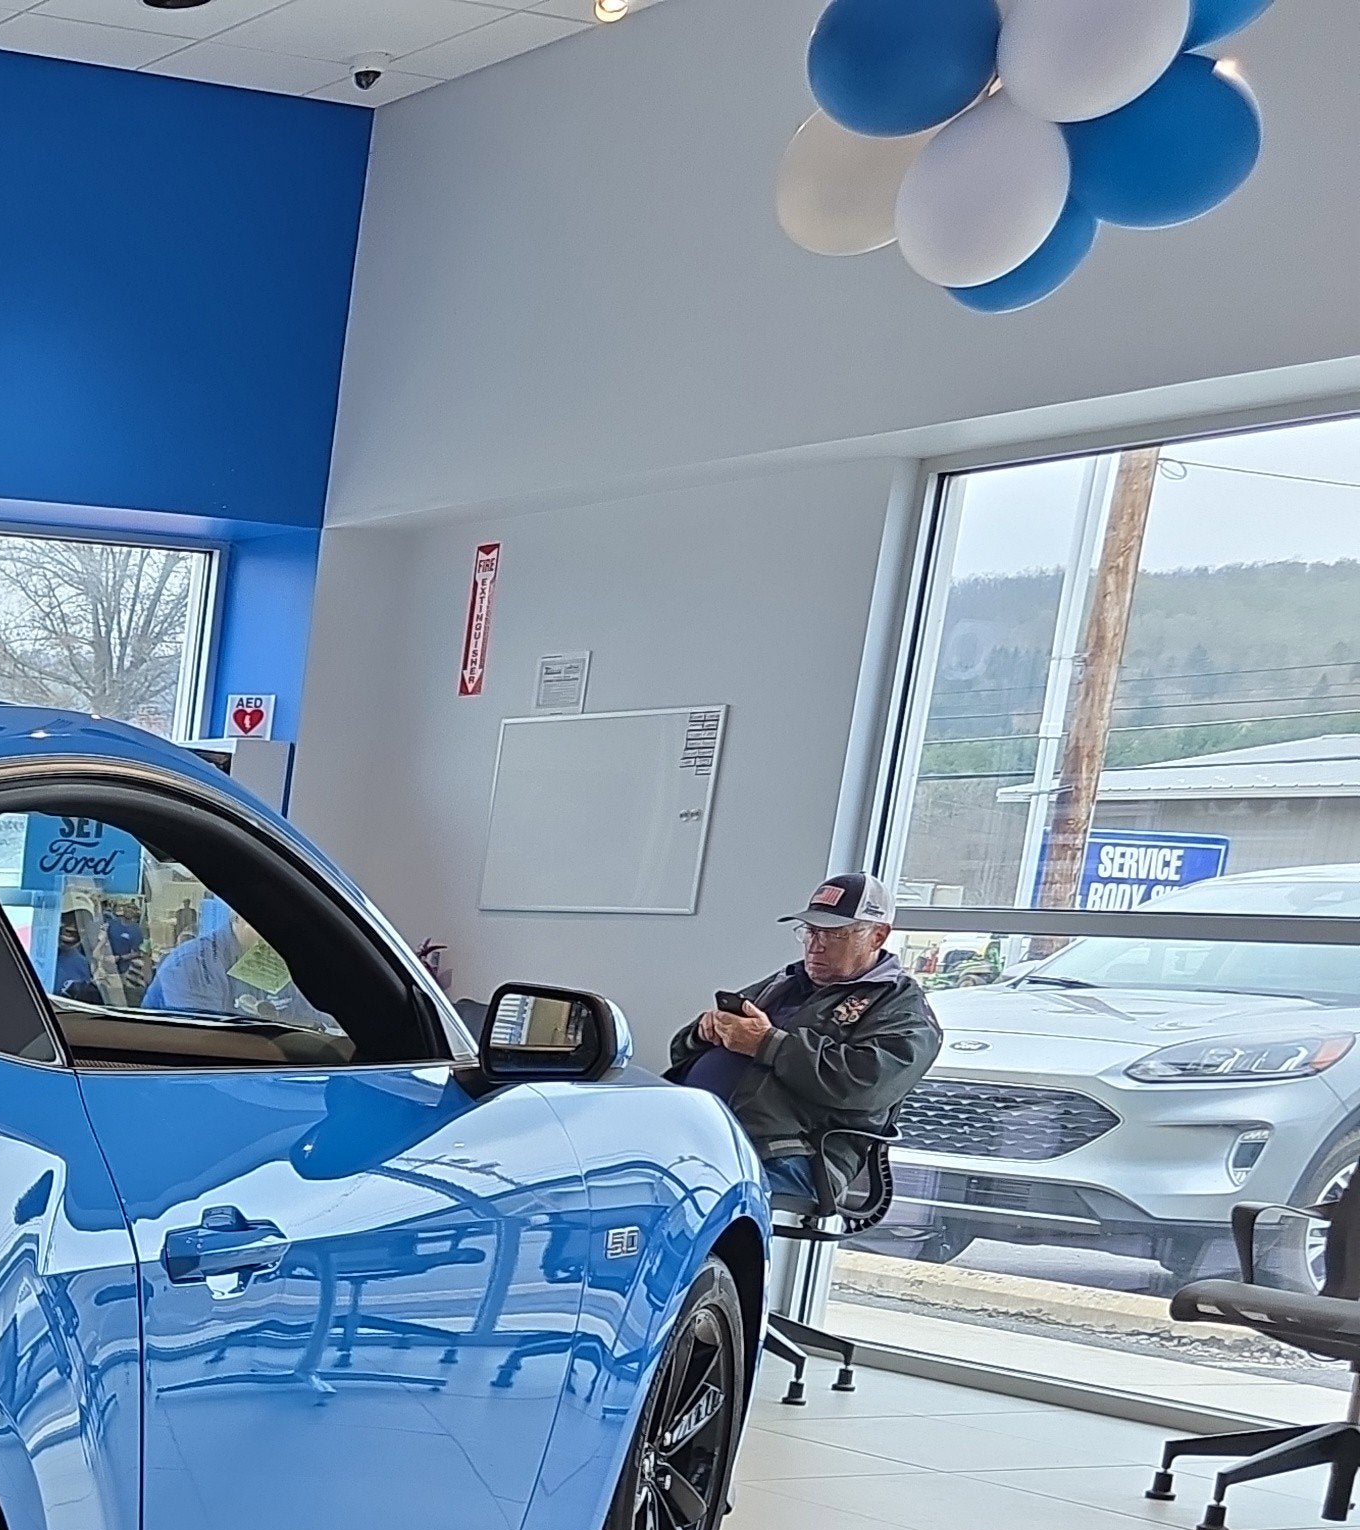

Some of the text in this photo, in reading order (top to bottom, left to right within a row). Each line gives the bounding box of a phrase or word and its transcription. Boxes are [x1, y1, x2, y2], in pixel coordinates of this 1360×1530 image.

[468, 578, 488, 684] EXTINGUISHER
[236, 697, 263, 708] AED
[40, 839, 125, 876] Ford
[1098, 845, 1184, 881] SERVICE
[1086, 882, 1148, 911] BODY
[605, 1226, 640, 1259] 5.0
